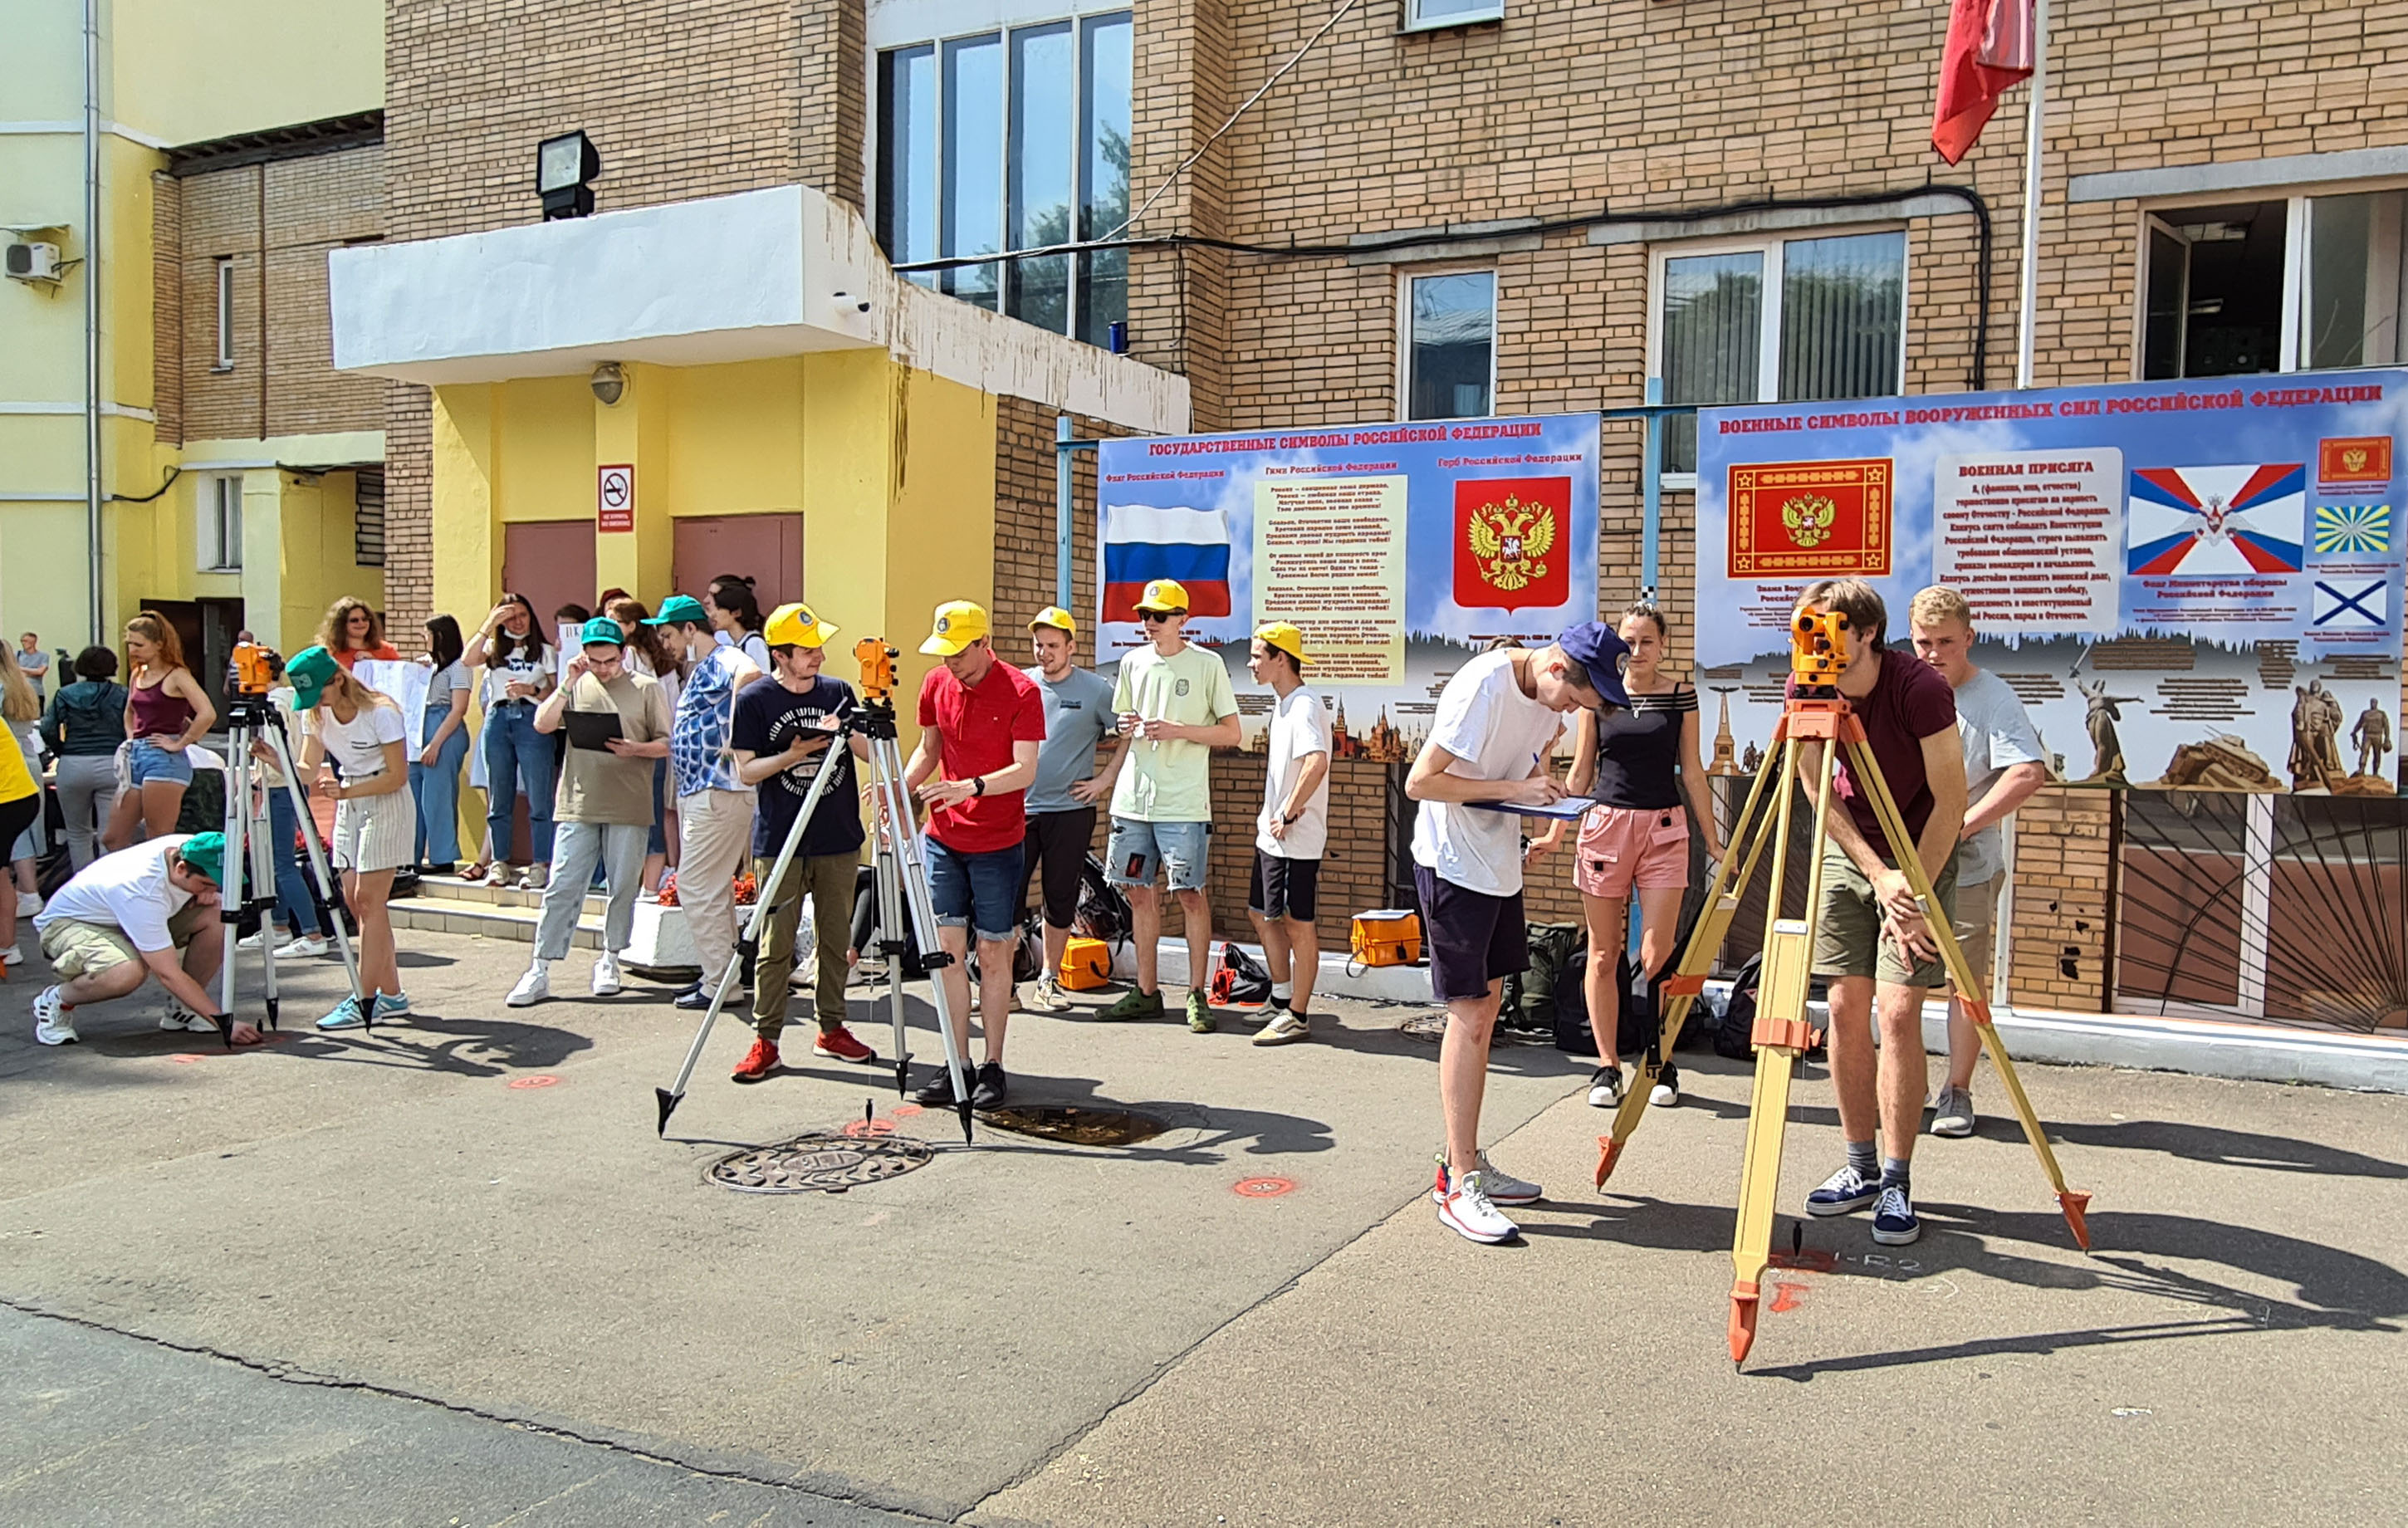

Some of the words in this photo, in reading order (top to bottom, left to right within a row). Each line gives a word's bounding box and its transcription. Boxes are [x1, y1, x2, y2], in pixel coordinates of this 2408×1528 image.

[1720, 418, 1802, 433] ВОЕННЫЕ
[1808, 411, 1900, 429] СИМВОЛЫ
[1905, 403, 2053, 424] ВООРУЖЕННЫХ
[2060, 399, 2100, 415] СИЛ
[2106, 389, 2244, 414] РОССИЙСКОЙ
[2250, 385, 2381, 406] ФЕДЕРАЦИИ
[1149, 438, 1275, 456] ГОСУДАРСТВЕННЫЕ
[1280, 434, 1348, 448] СИМВОЛЫ
[1353, 426, 1446, 445] РОССИЙСКОЙ
[1452, 424, 1541, 441] ФЕДЕРАЦИИ
[1290, 463, 1343, 473] Российской
[1346, 463, 1397, 472] Федерации
[1438, 458, 1461, 469] Герб
[1463, 455, 1521, 465] Российской
[1525, 454, 1582, 463] Федерации
[1127, 472, 1175, 481] Российской
[1177, 470, 1224, 479] Федерации
[1959, 464, 2024, 477] ВОЕННАЯ
[2029, 462, 2094, 474] ПРИСЯГА
